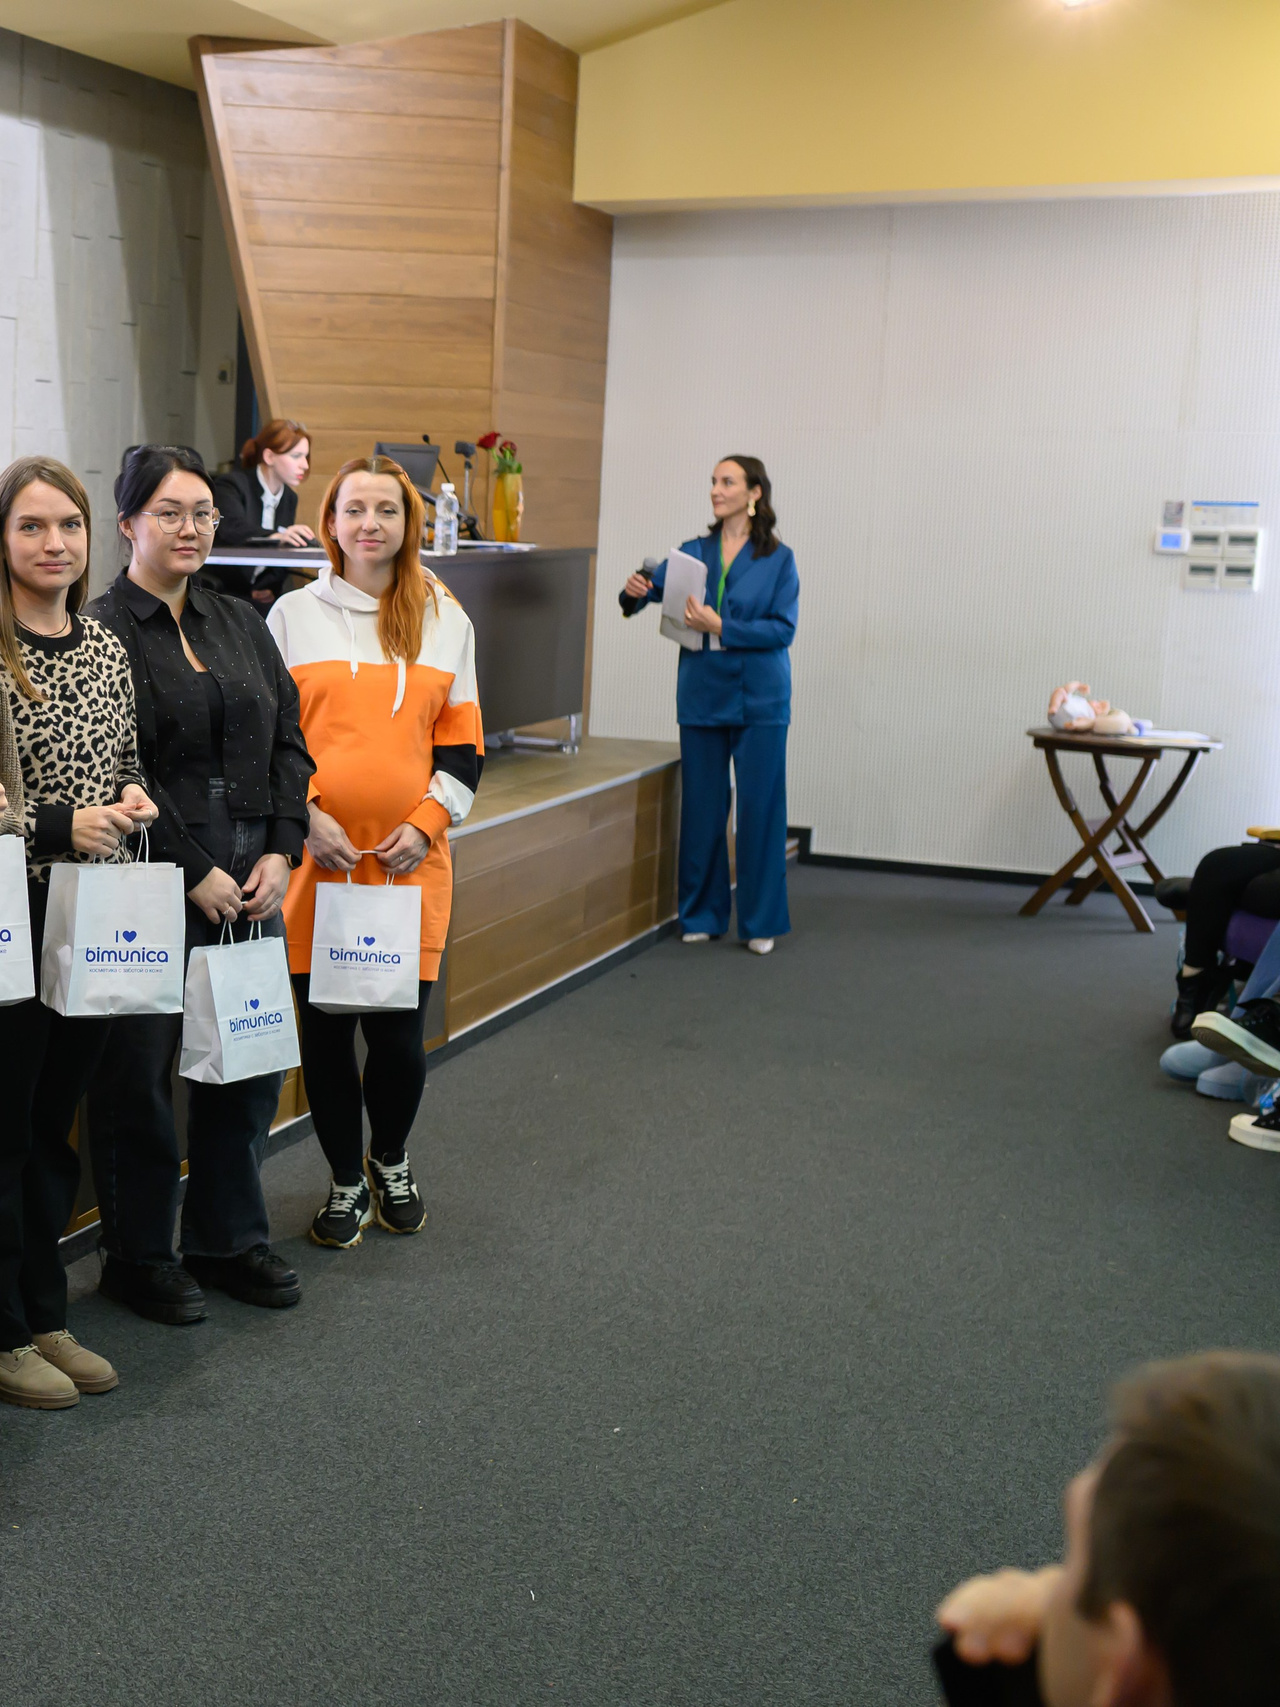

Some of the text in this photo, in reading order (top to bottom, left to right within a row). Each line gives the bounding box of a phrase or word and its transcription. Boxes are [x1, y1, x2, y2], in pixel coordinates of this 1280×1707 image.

[85, 947, 168, 963] bimunica
[329, 947, 401, 964] bimunica
[229, 1012, 283, 1033] bimunica
